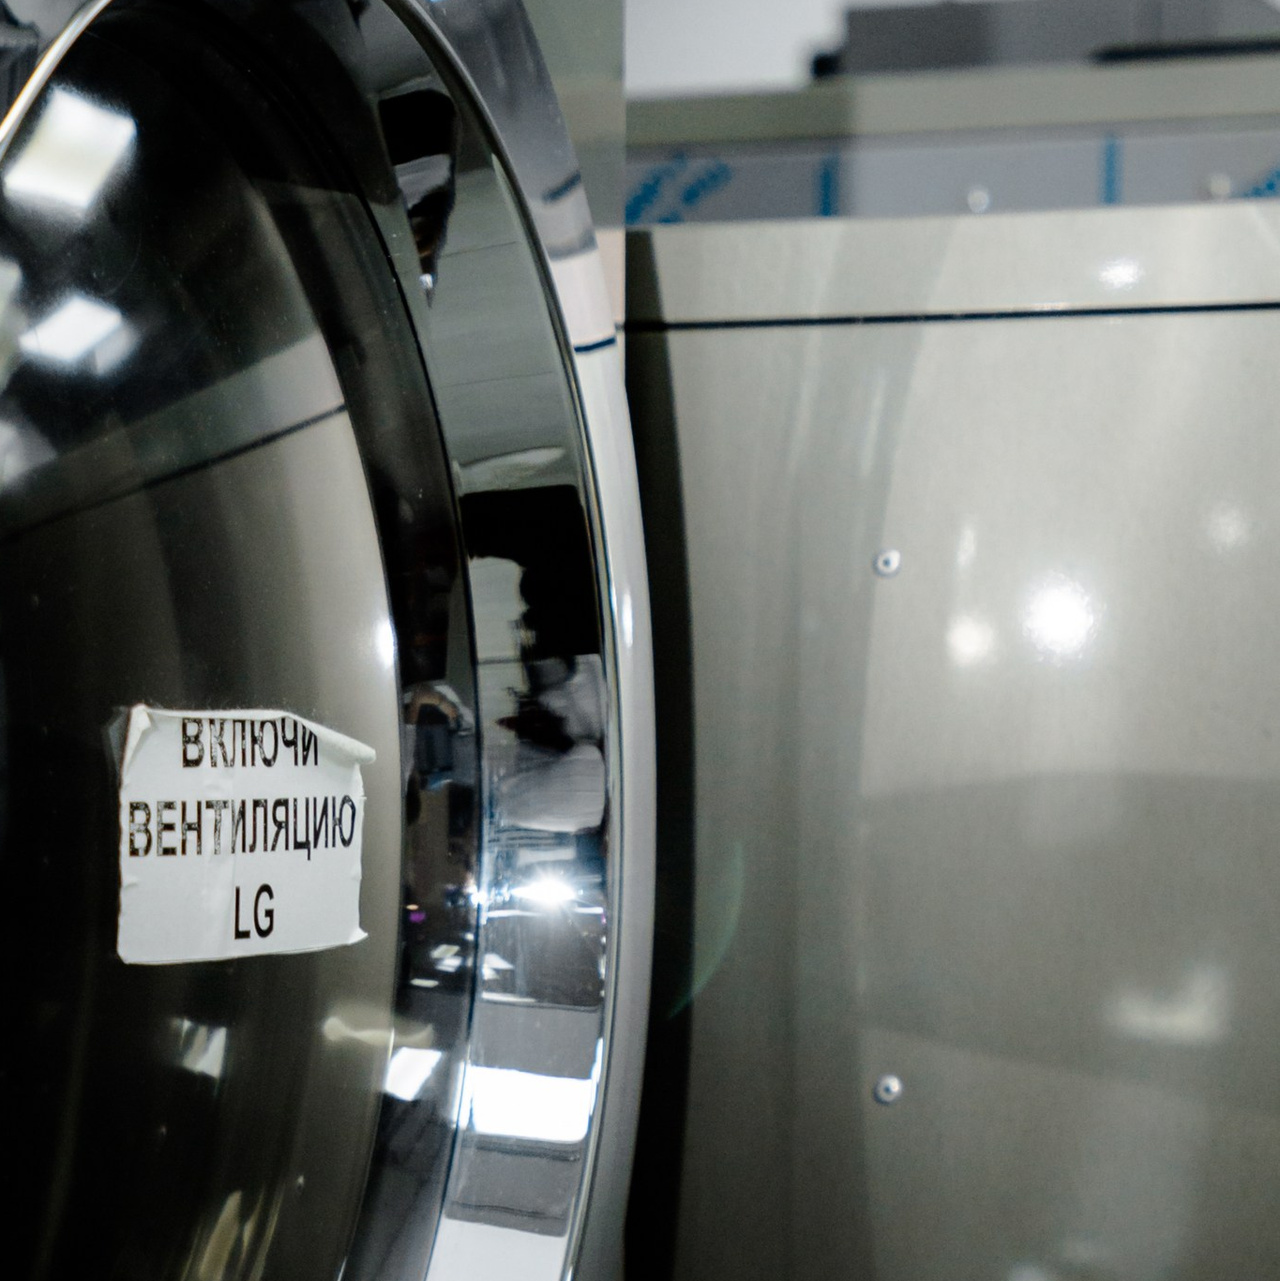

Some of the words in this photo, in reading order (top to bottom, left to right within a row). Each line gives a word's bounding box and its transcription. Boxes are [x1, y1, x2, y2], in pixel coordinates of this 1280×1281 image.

[182, 716, 319, 769] ВКЛЮЧИ
[128, 794, 357, 862] ВЕНТИЛЯЦИЮ
[234, 882, 275, 941] LG
